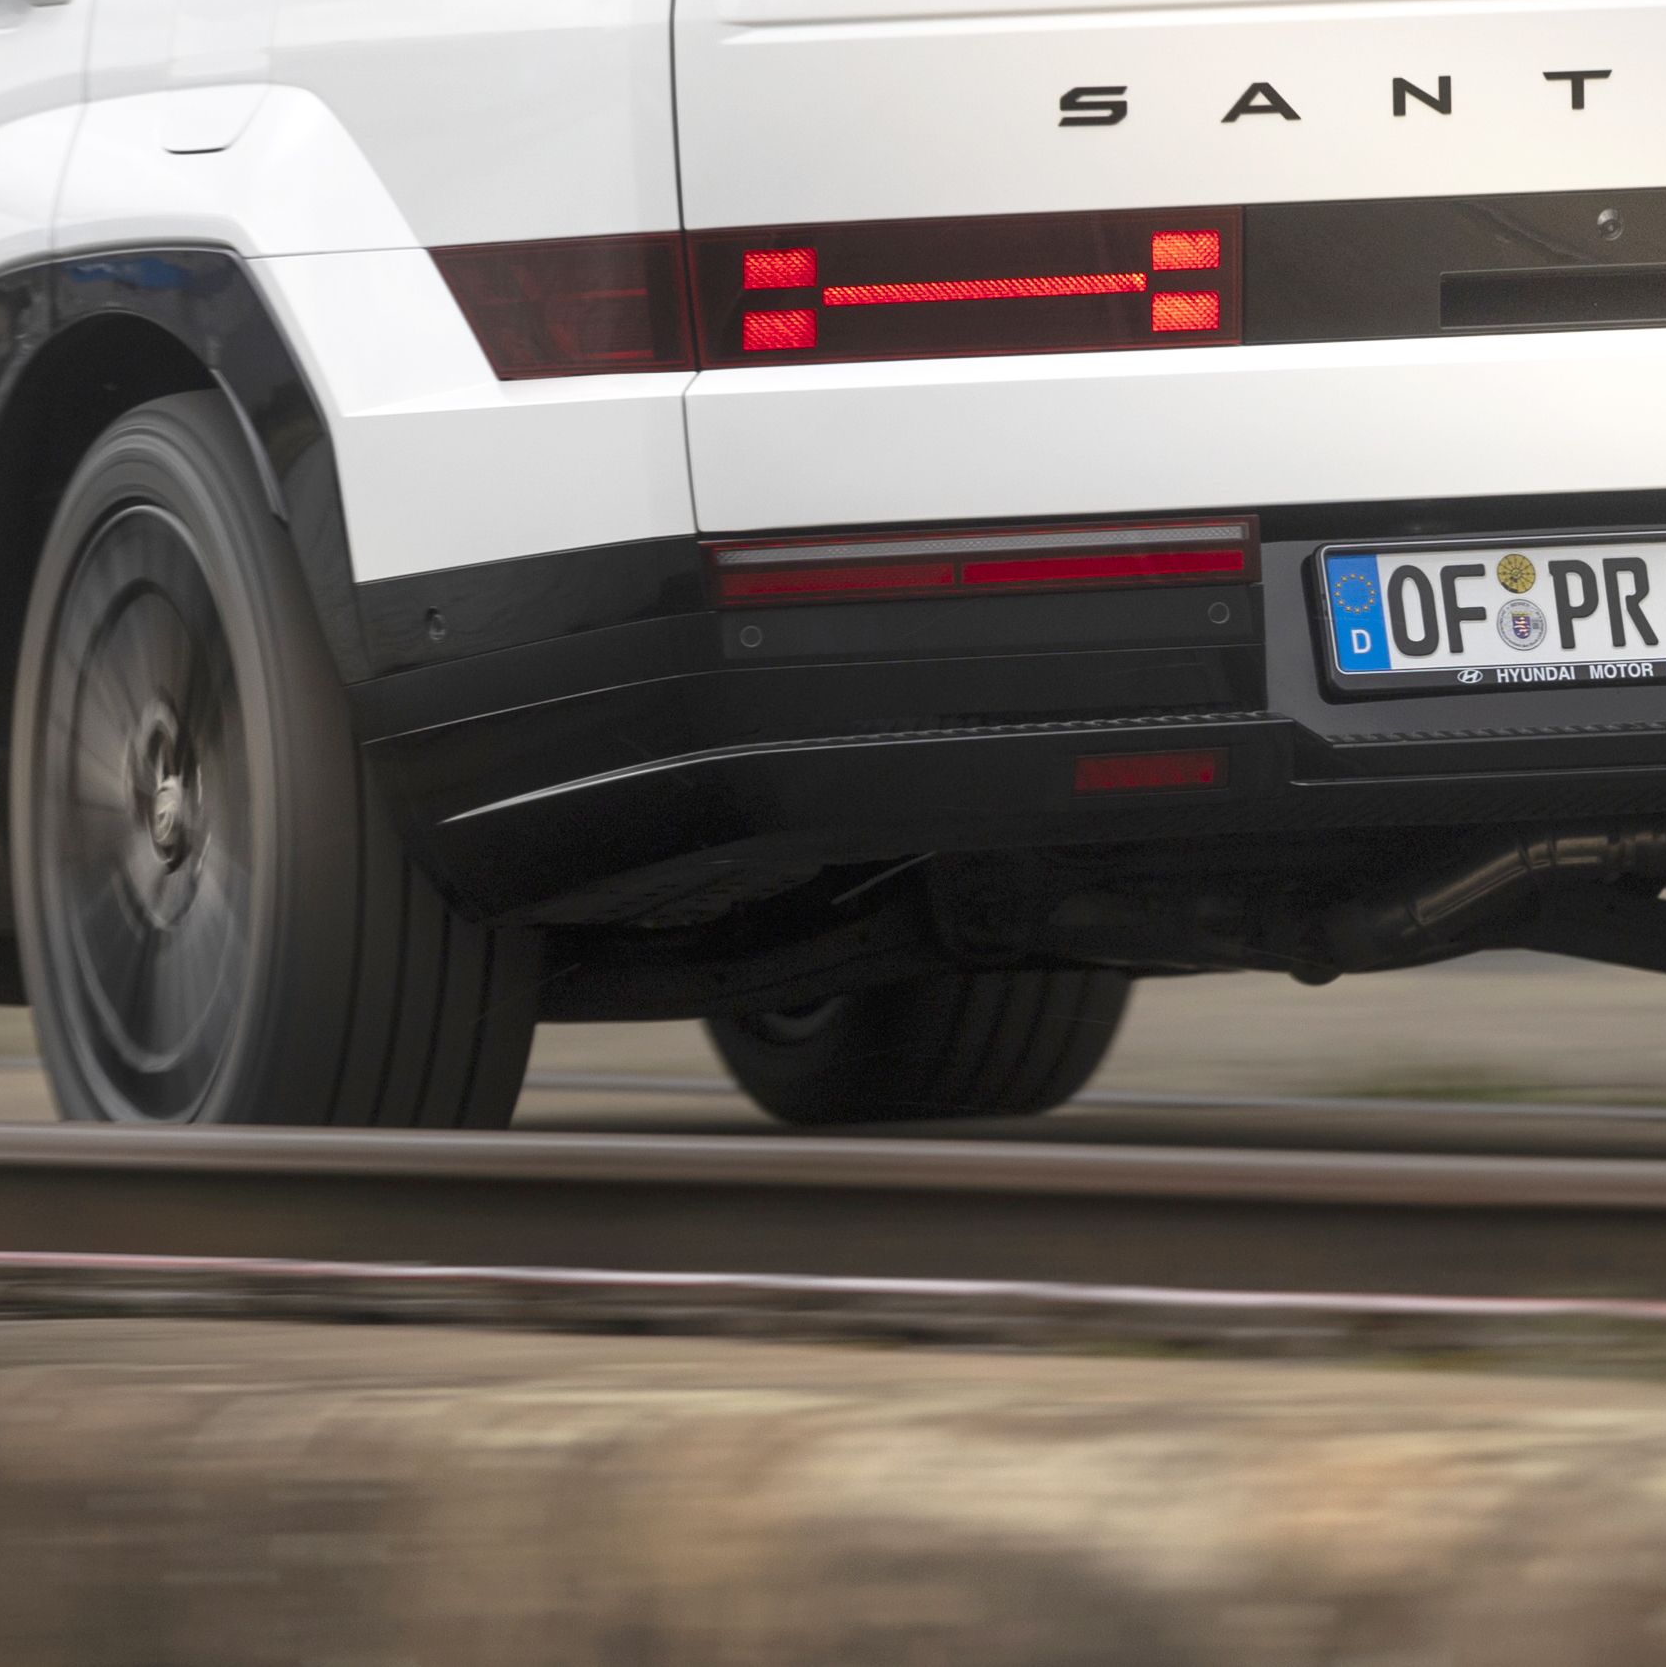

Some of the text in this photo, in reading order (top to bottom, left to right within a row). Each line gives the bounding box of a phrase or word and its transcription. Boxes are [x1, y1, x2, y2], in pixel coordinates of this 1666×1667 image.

[1387, 563, 1487, 656] OF
[1548, 557, 1659, 650] PR
[1351, 629, 1371, 654] D
[1496, 665, 1576, 683] HYUNDAI
[1589, 662, 1654, 680] MOTOR
